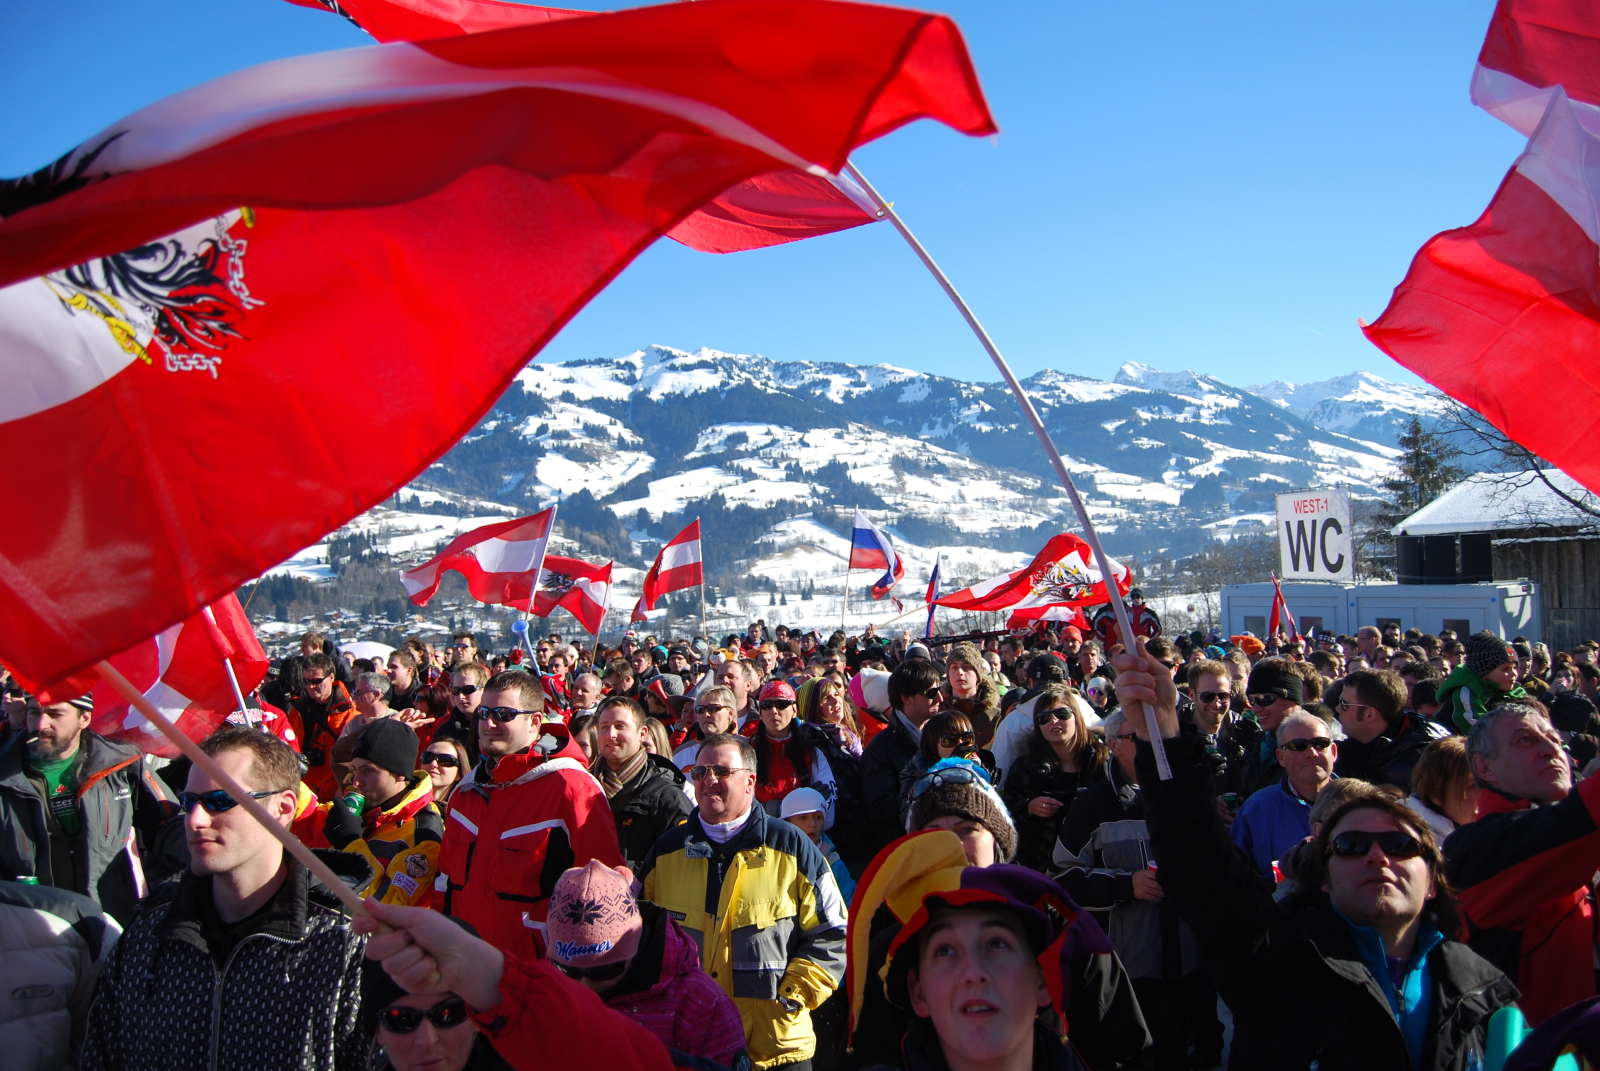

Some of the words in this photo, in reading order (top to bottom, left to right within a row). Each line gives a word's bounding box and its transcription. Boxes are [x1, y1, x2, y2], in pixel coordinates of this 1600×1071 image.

[1293, 498, 1329, 514] WEST-1
[1285, 517, 1344, 573] WC
[555, 940, 614, 961] Manner
